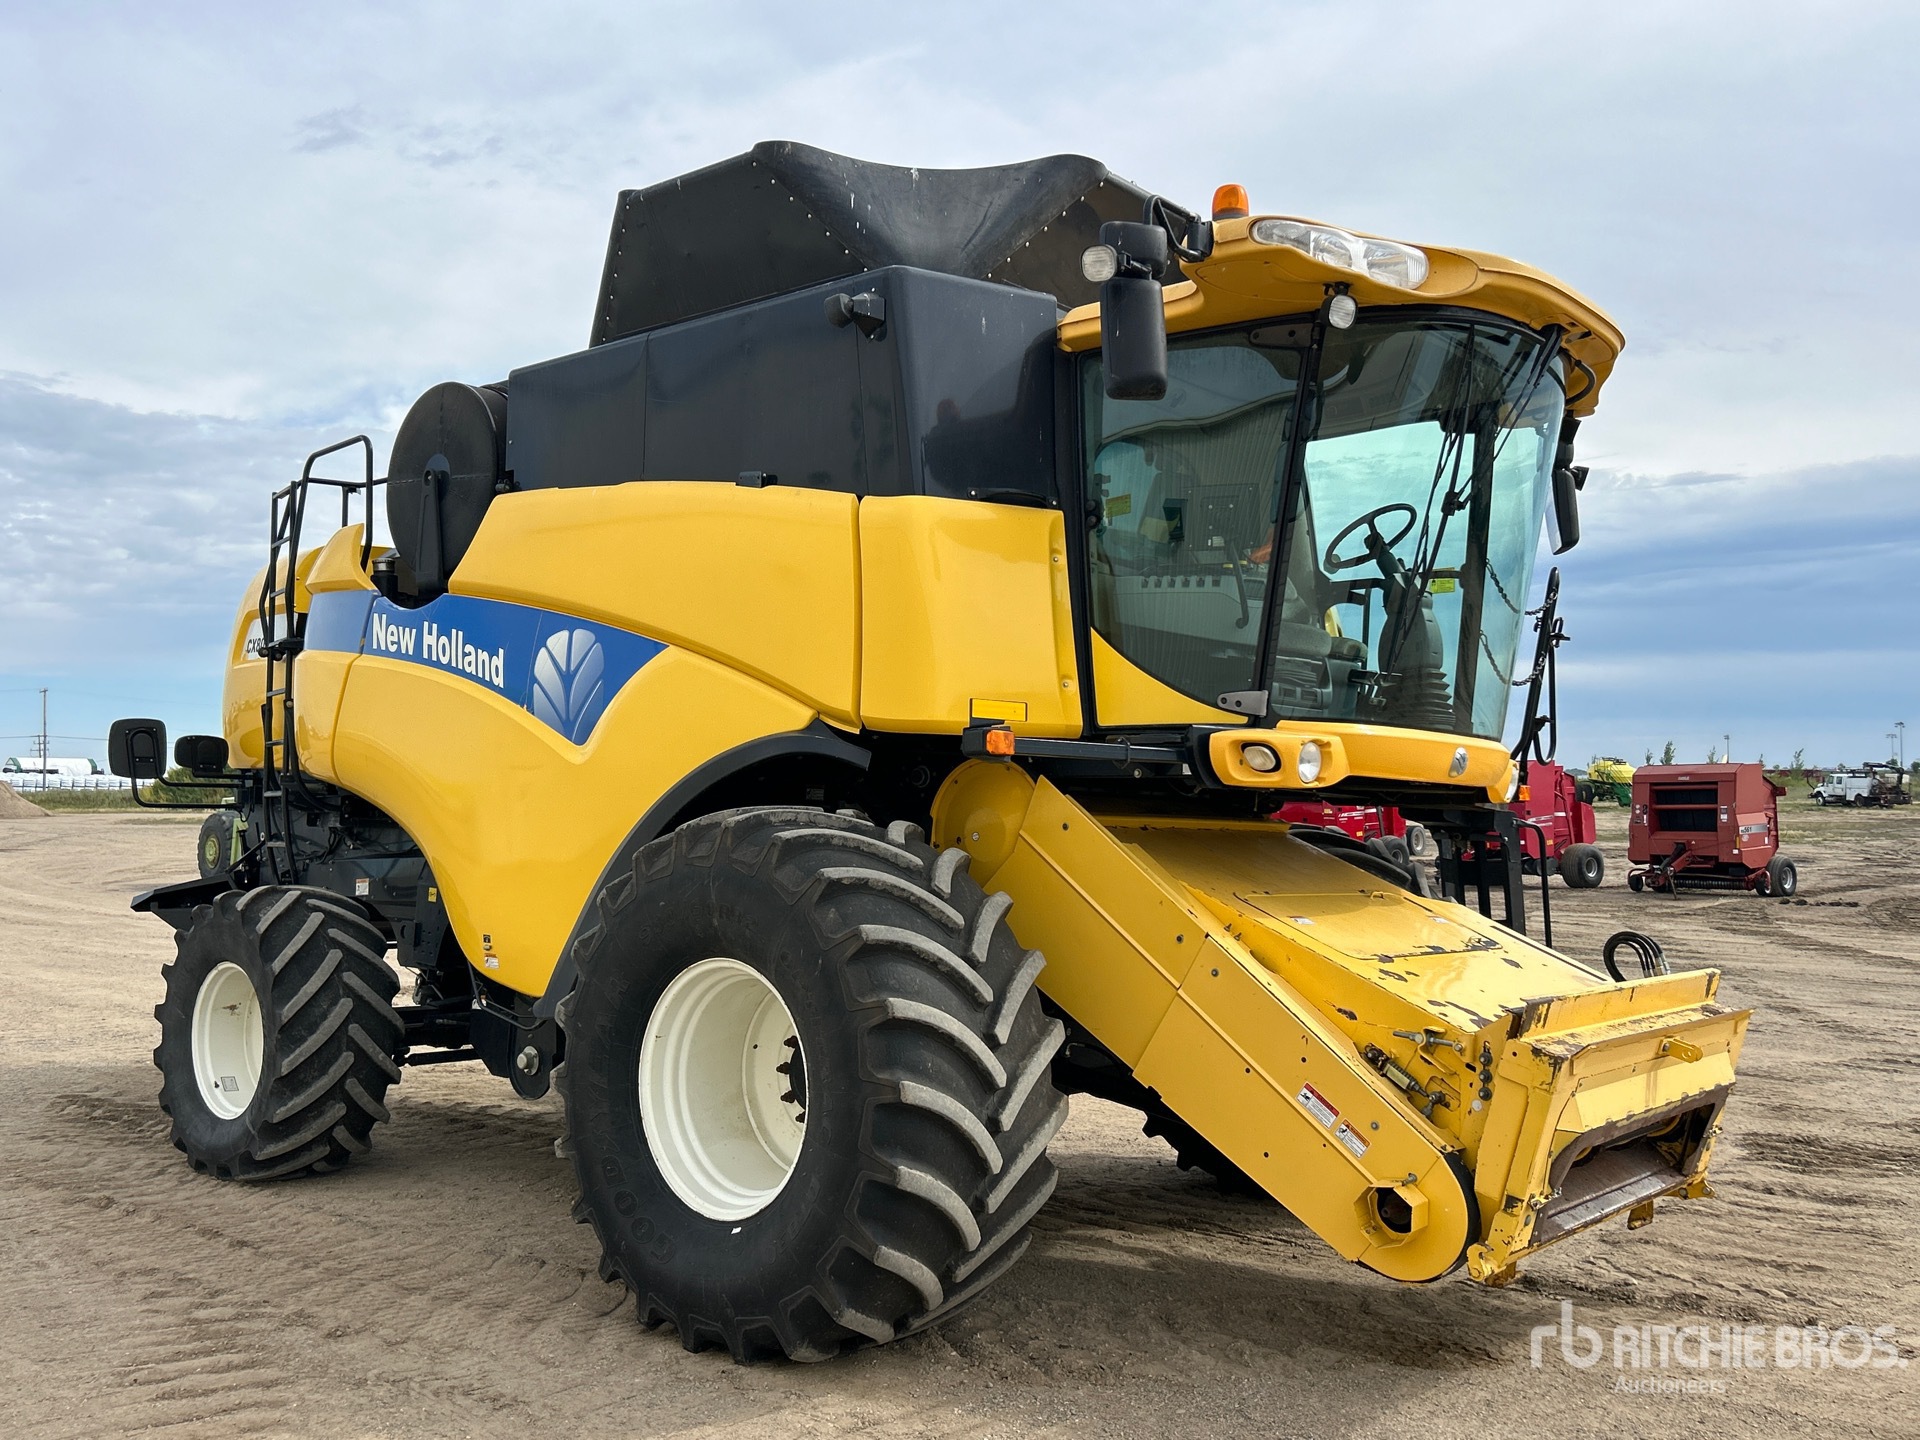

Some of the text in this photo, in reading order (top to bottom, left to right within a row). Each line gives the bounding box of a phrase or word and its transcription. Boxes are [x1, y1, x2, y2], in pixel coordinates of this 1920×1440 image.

[372, 613, 504, 688] New Holland
[588, 974, 678, 1266] GOODYEAR
